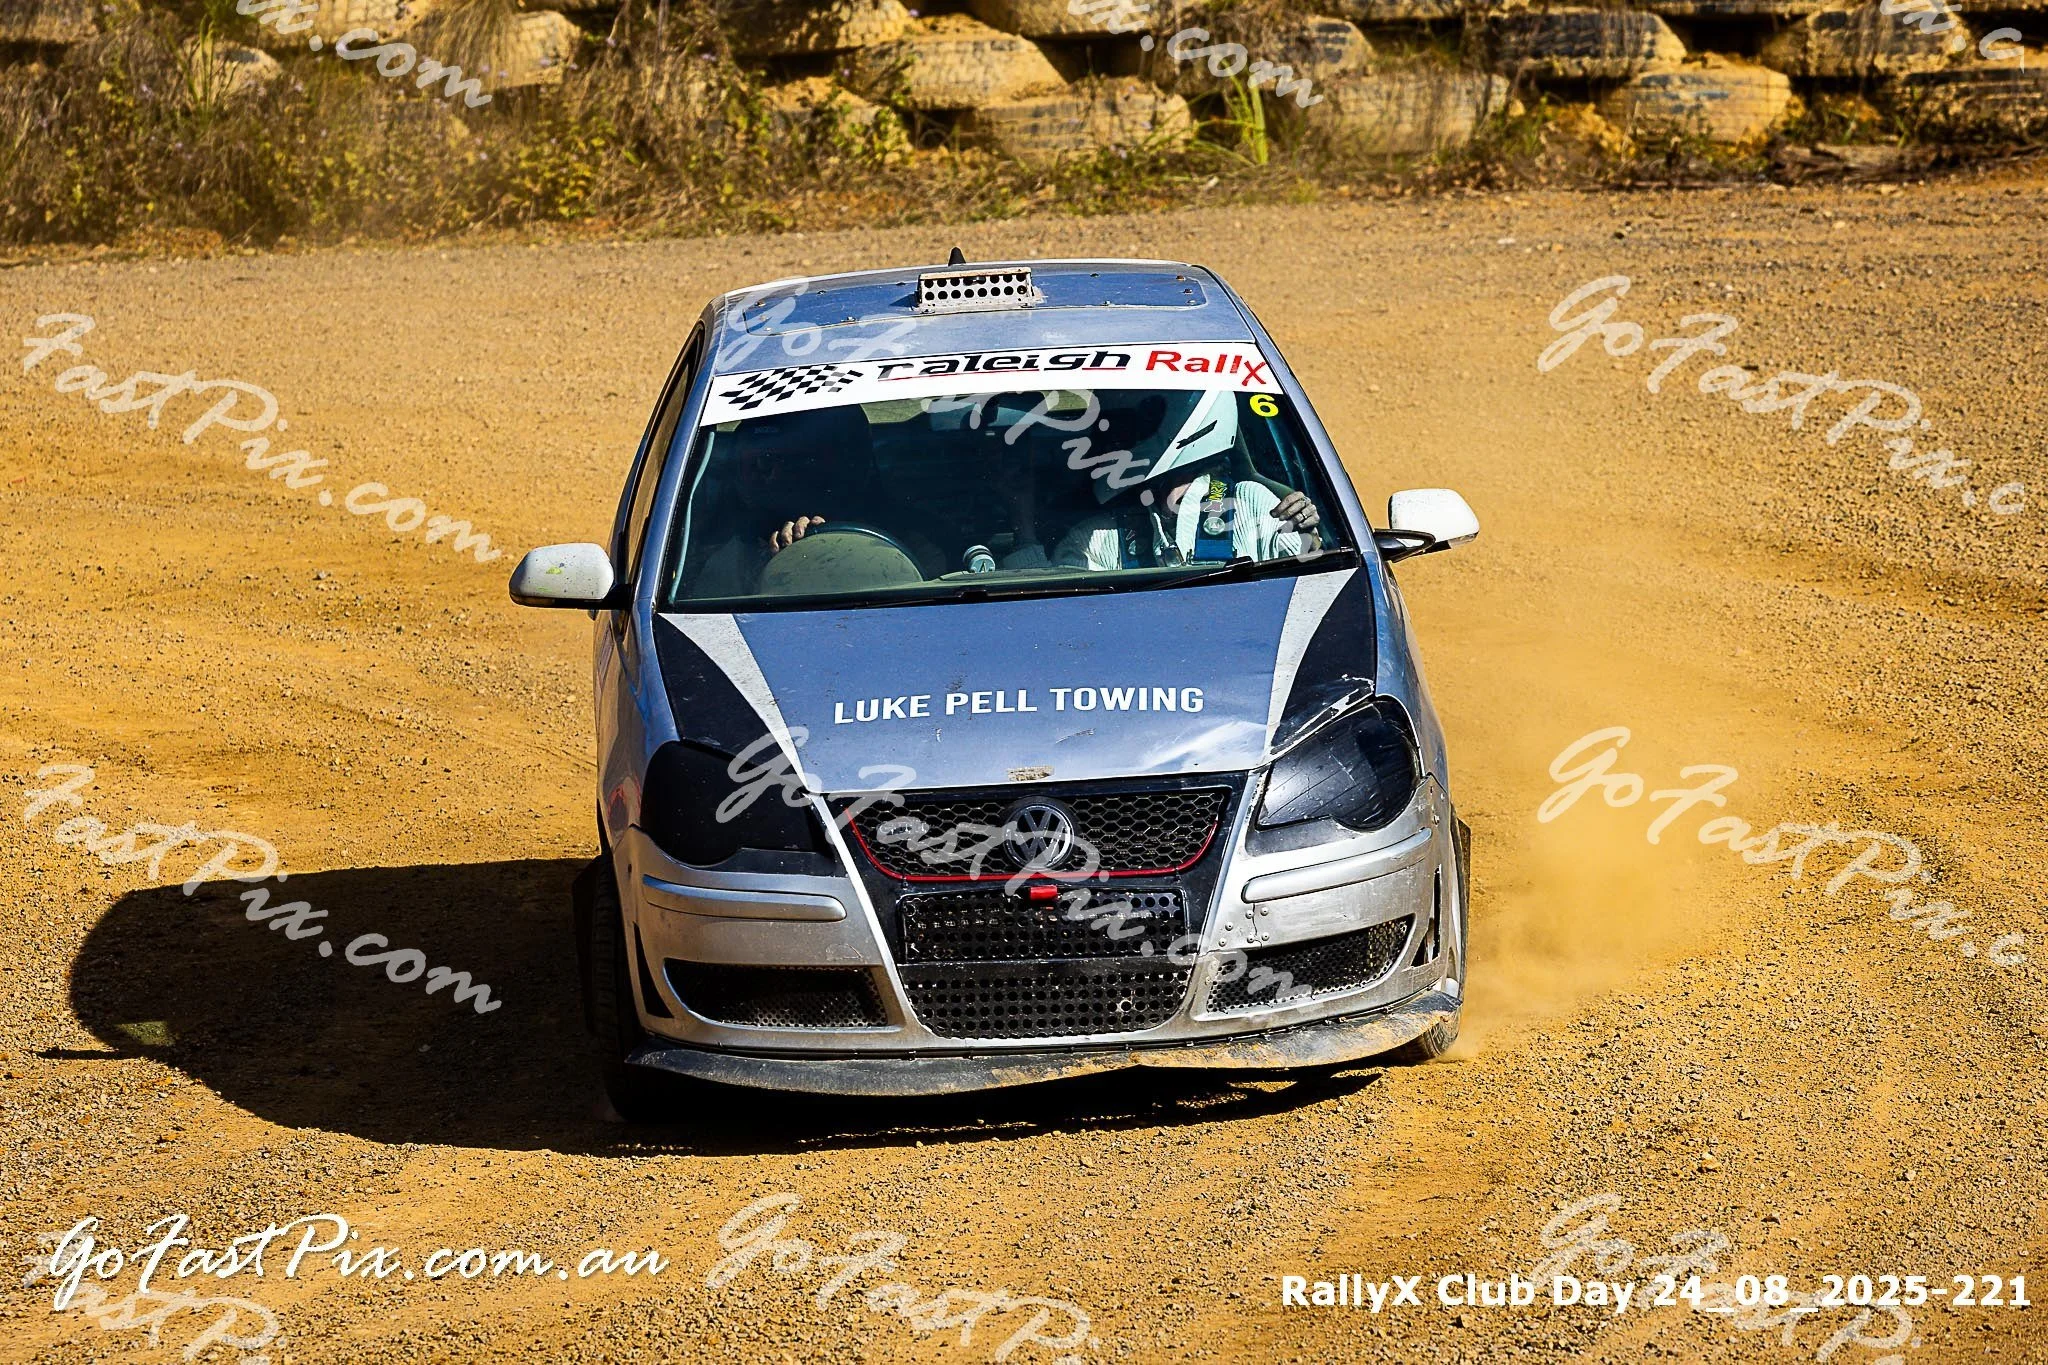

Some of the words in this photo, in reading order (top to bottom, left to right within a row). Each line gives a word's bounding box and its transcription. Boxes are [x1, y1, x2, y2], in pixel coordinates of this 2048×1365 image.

[1249, 394, 1279, 417] 6
[834, 694, 931, 724] LUKE
[945, 689, 1038, 715] PELL
[1050, 687, 1204, 712] TOWING
